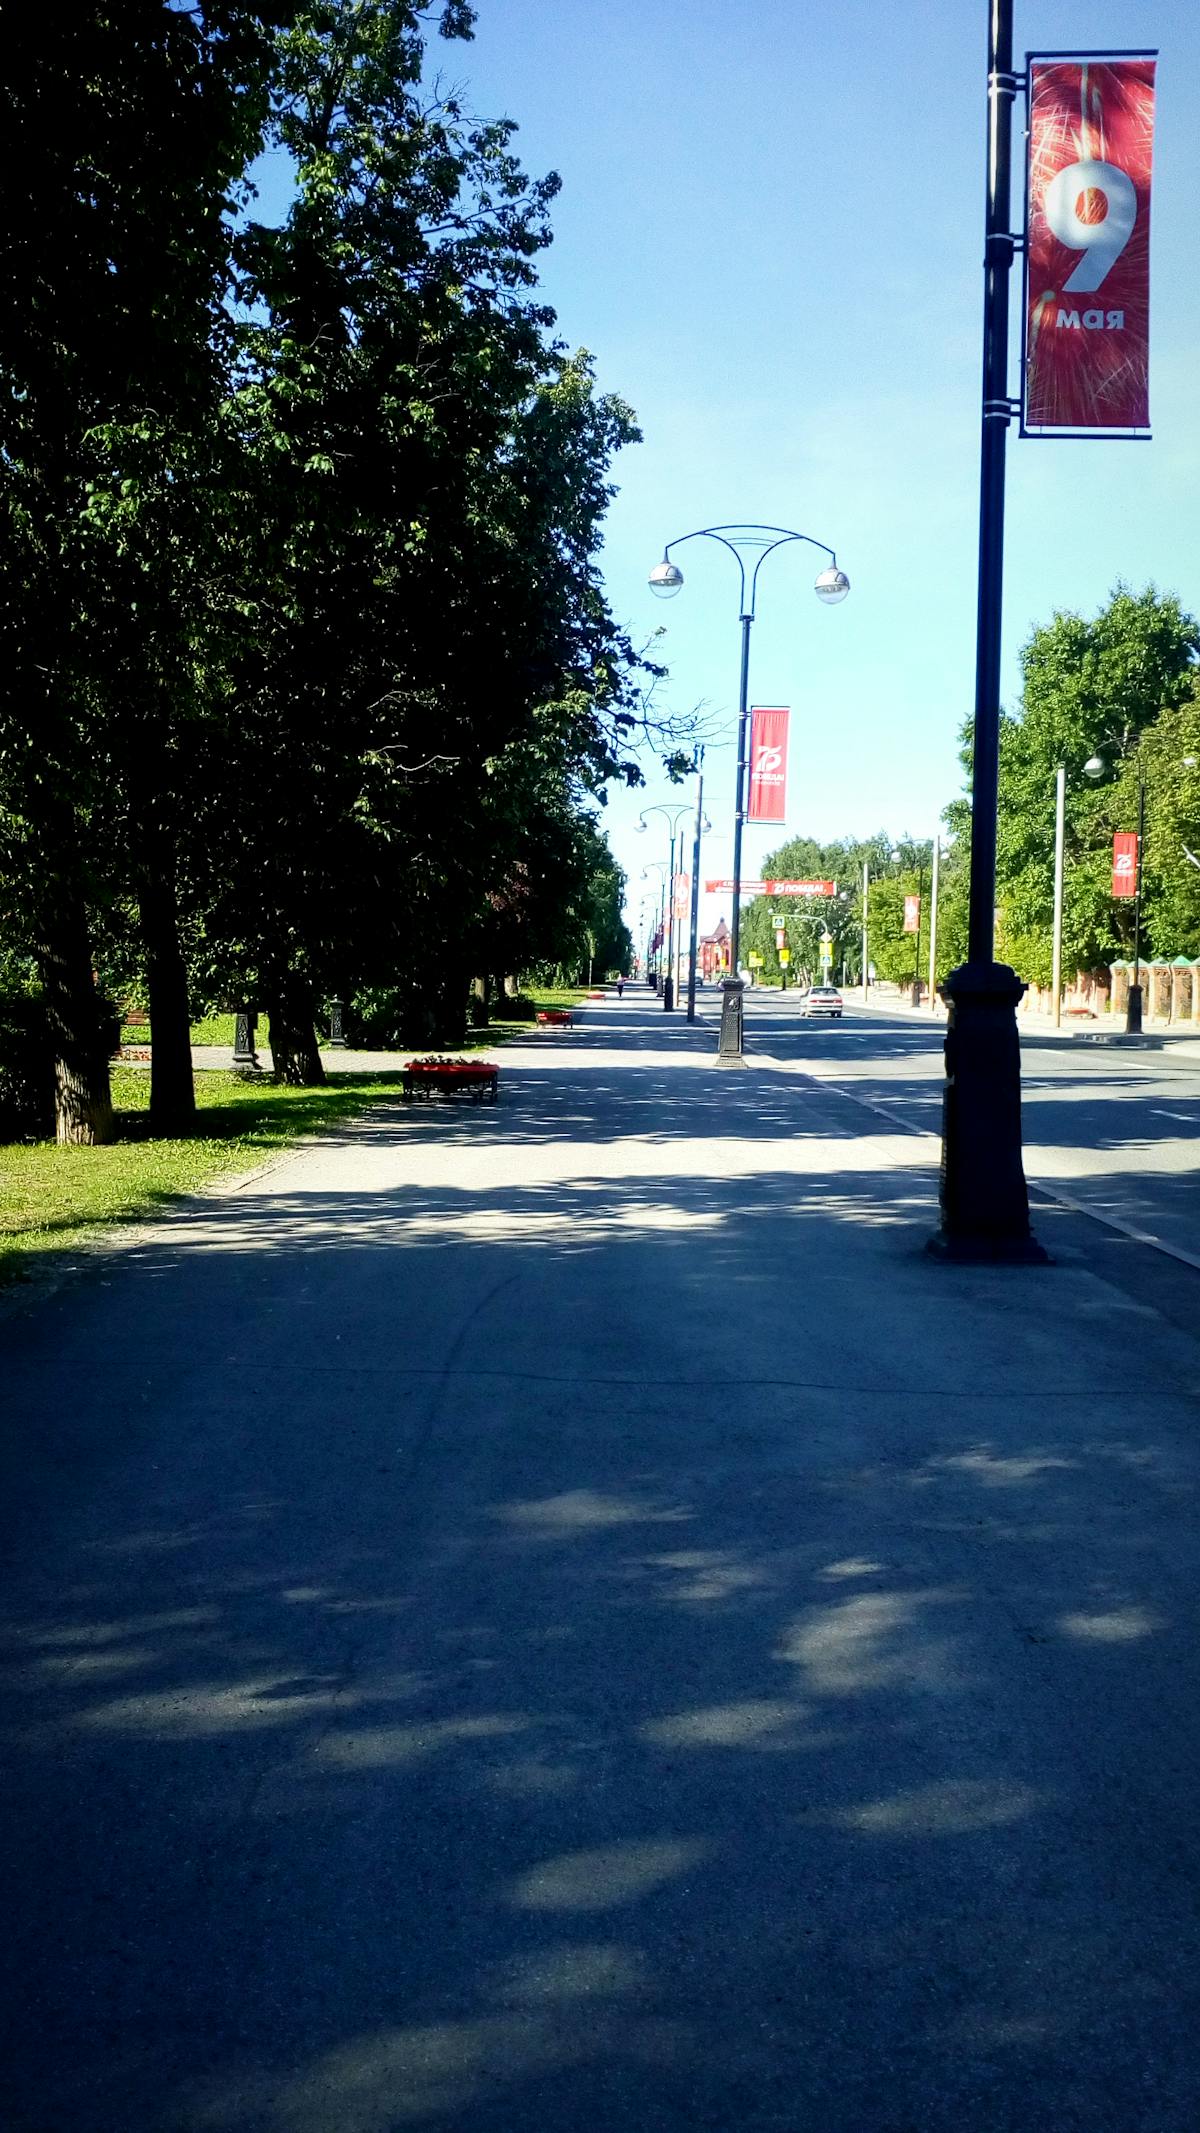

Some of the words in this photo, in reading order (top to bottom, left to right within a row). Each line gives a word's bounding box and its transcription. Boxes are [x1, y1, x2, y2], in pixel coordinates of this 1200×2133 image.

[1045, 160, 1137, 292] 9
[1056, 308, 1124, 329] мая
[756, 745, 783, 771] 75
[1115, 853, 1132, 868] 75
